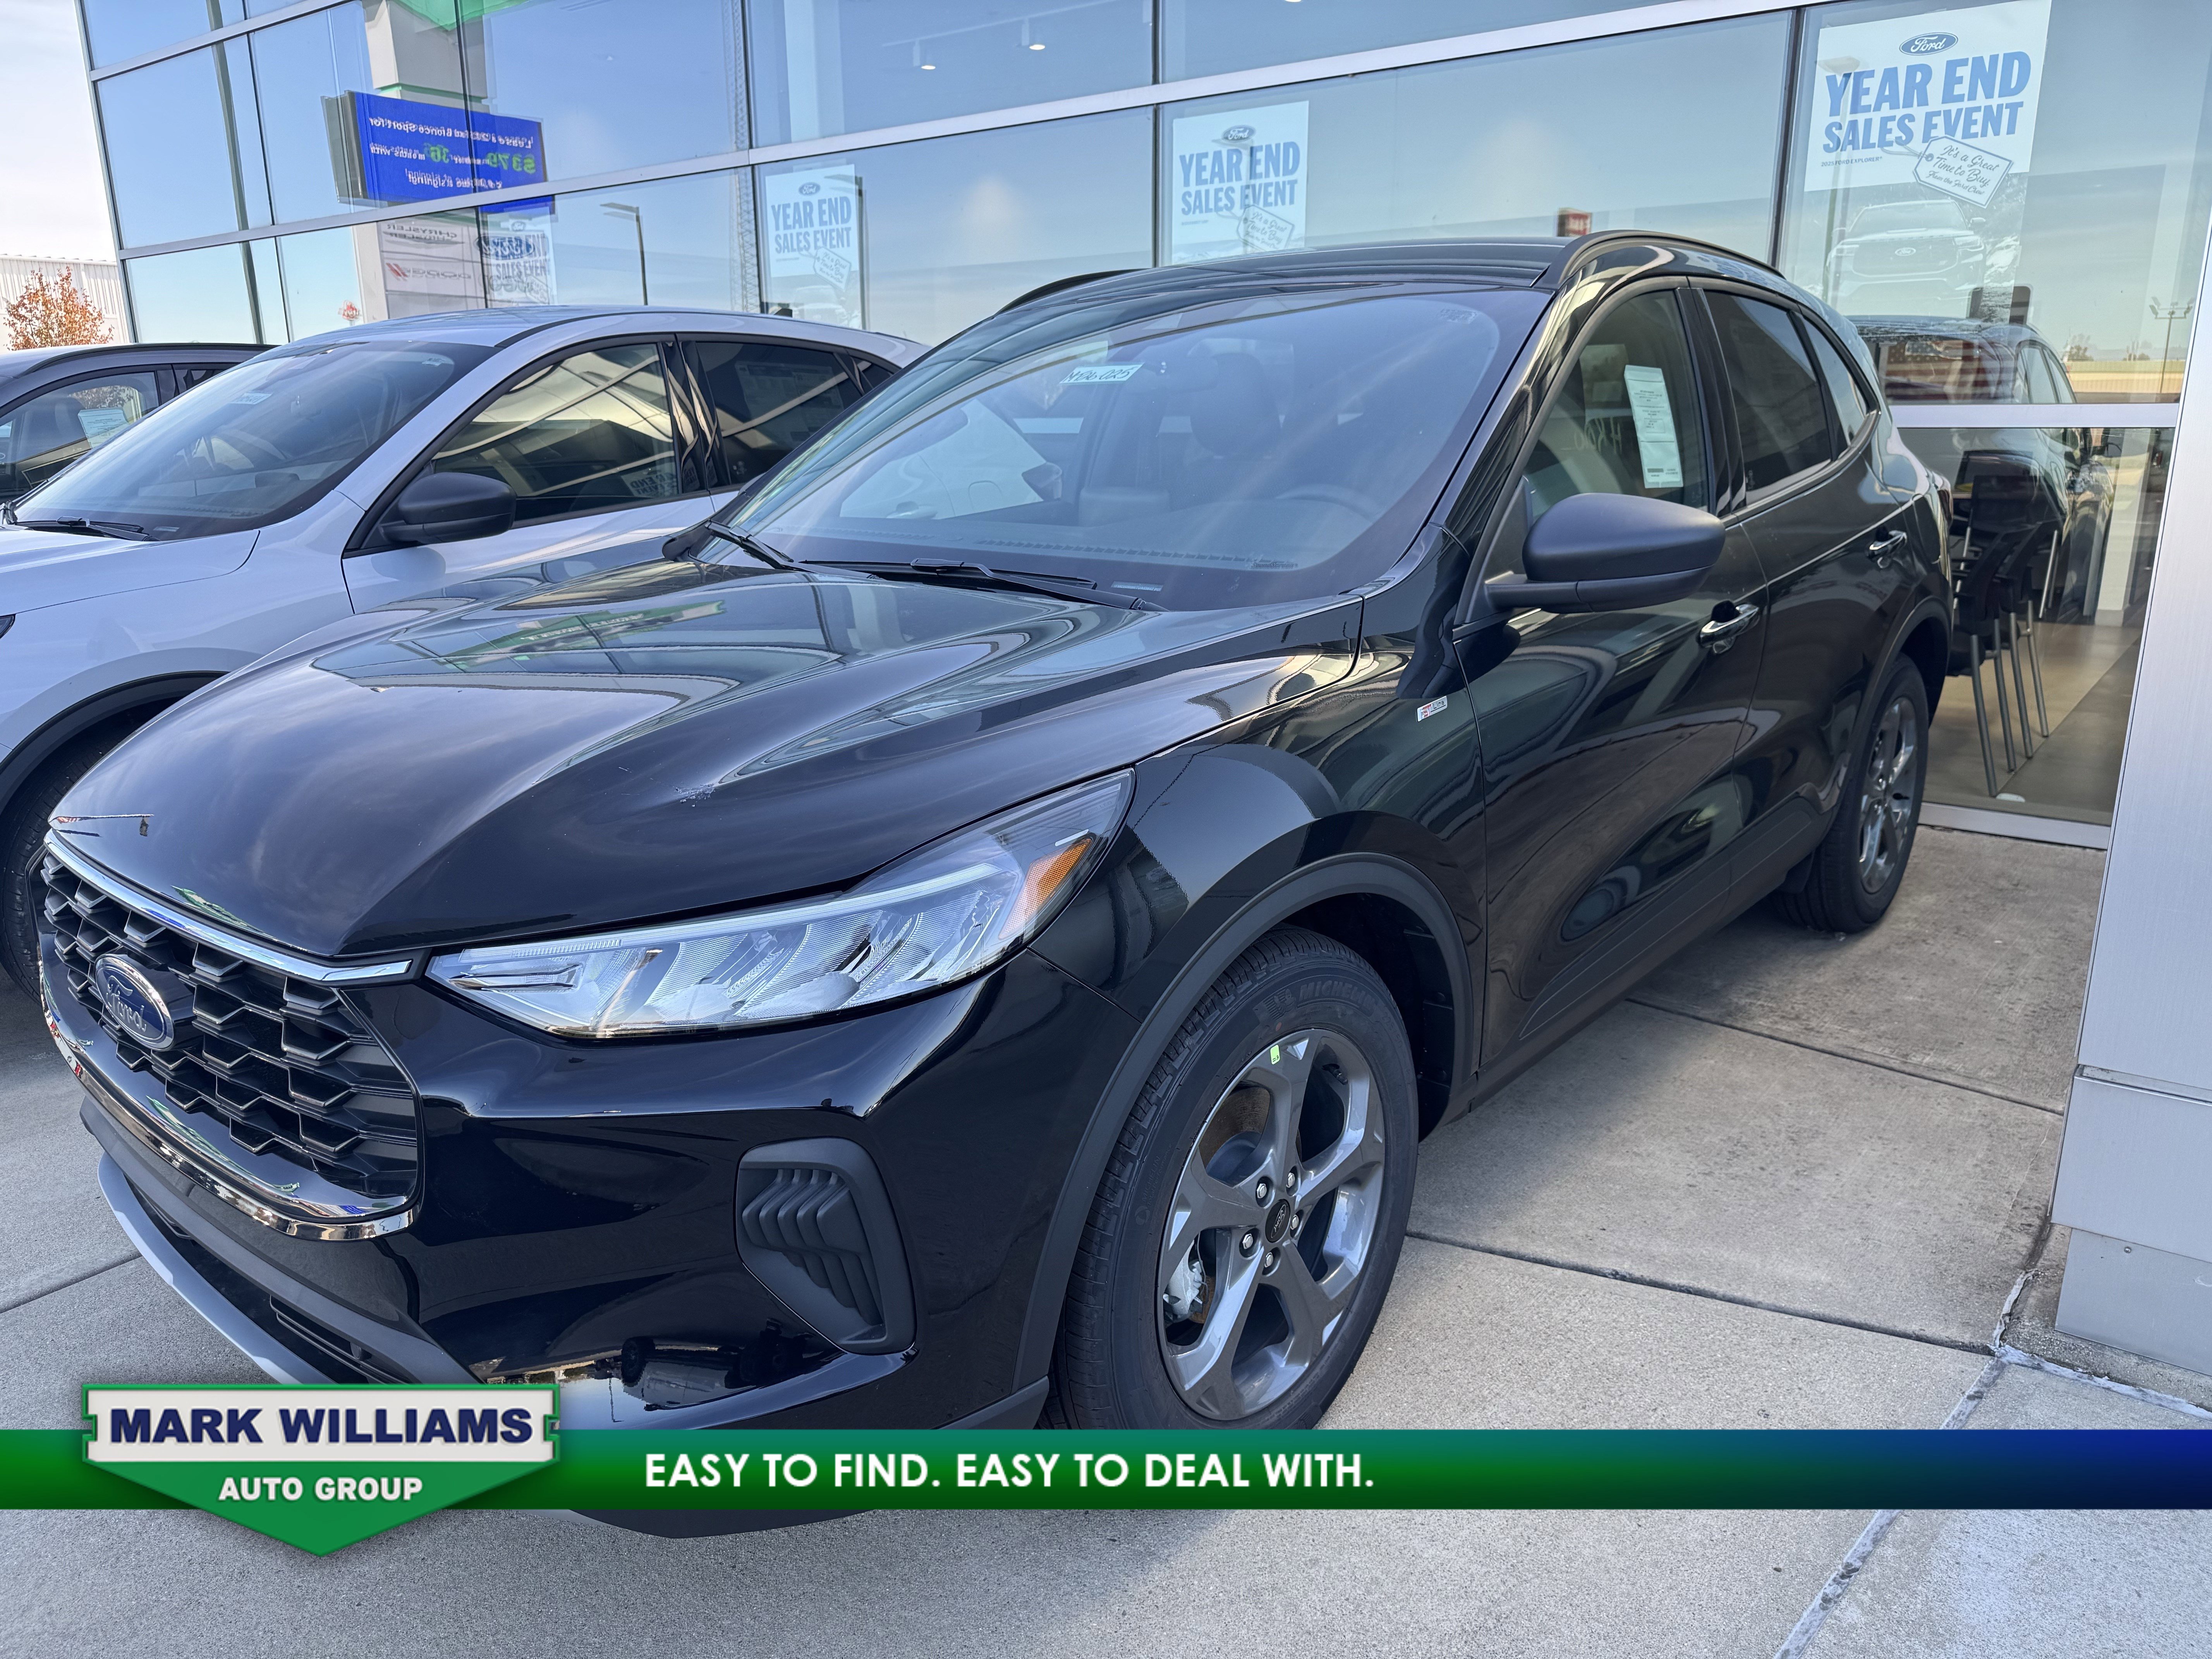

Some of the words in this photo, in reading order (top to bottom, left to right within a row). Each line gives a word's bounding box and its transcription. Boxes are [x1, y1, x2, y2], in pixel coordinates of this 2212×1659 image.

[1911, 36, 1944, 53] Ford
[1826, 64, 1932, 117] YEAR
[1941, 51, 2031, 104] END
[1823, 113, 1915, 153] SALES
[1922, 101, 2023, 143] EVENT
[1179, 148, 1243, 187] YEAR
[1250, 141, 1300, 180] END
[1933, 156, 1953, 173] Time
[1954, 165, 1965, 176] to
[1940, 145, 1960, 158] It's
[1967, 155, 1999, 171] Great
[1181, 186, 1235, 216] SALES
[1240, 179, 1298, 210] EVENT
[1926, 170, 1942, 181] From
[1953, 180, 1969, 191] Ford
[1968, 187, 1984, 195] Crew
[771, 201, 814, 231] YEAR
[818, 196, 852, 227] END
[775, 231, 811, 254] SALES
[814, 227, 852, 251] EVENT
[1433, 700, 1444, 709] Line
[106, 975, 147, 1032] Ford
[1299, 980, 1376, 1008] MICHELIN
[1142, 1156, 1161, 1202] MICHELIN
